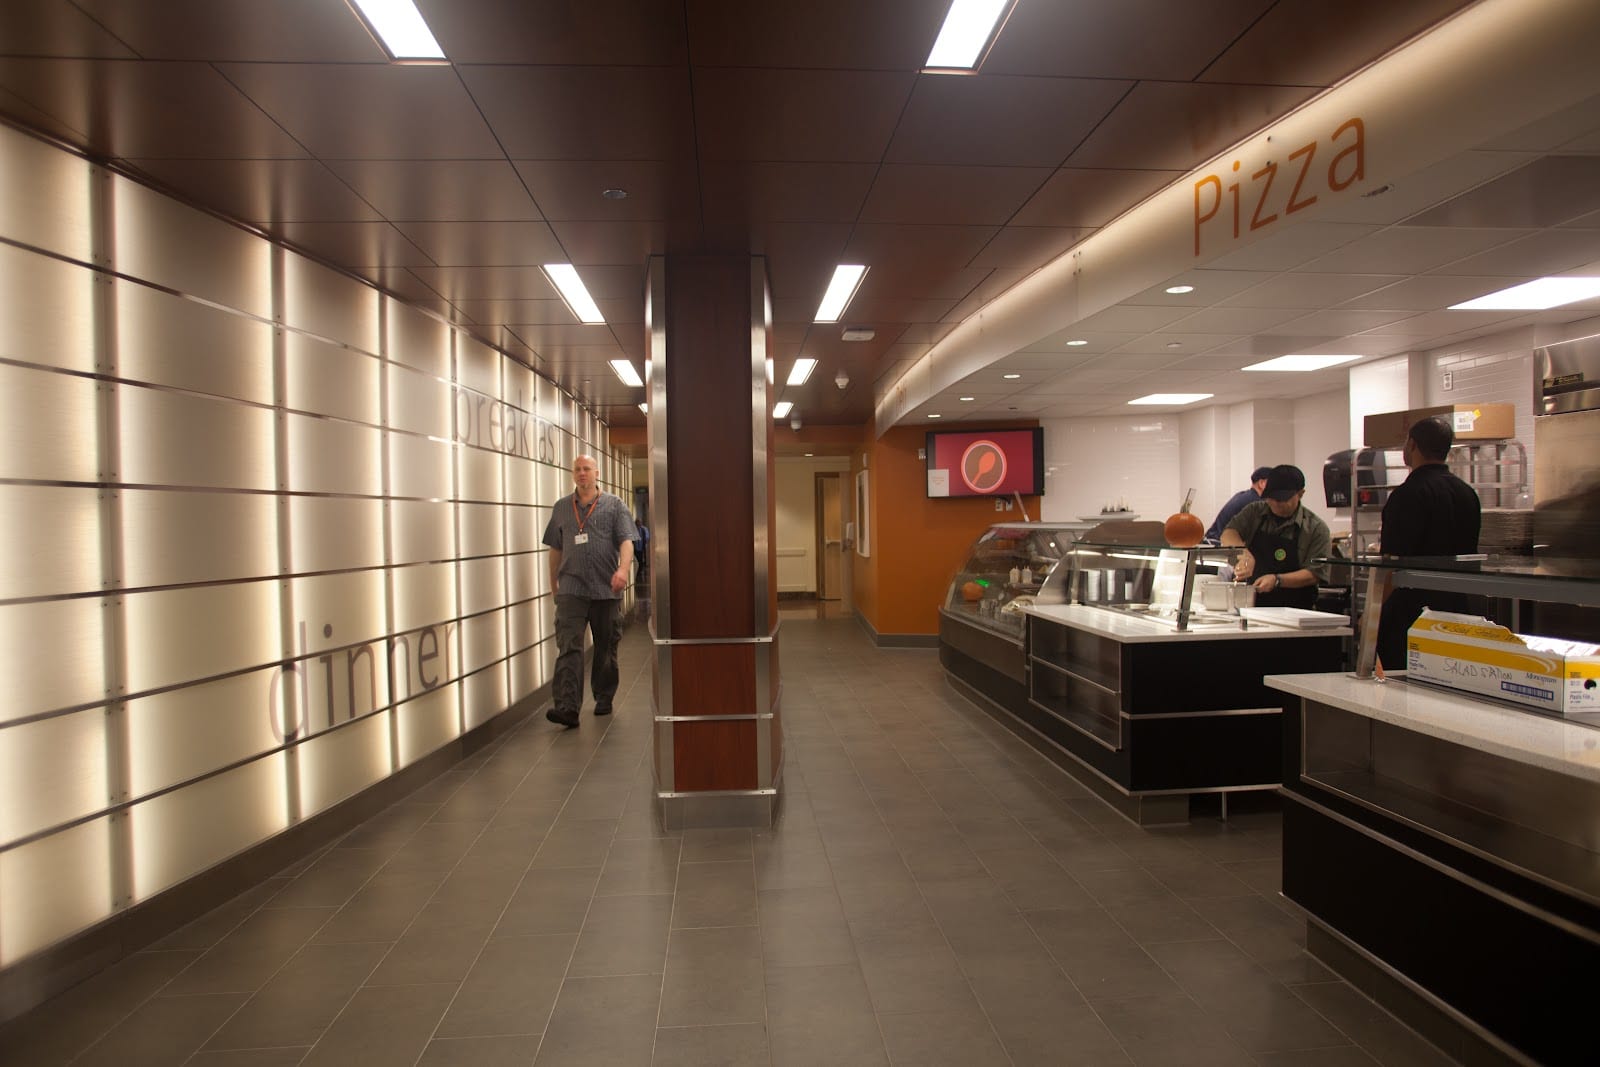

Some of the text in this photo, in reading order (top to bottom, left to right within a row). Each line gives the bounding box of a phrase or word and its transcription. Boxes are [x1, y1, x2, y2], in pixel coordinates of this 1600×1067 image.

[1194, 117, 1365, 257] Pizza
[453, 365, 561, 466] breakas
[269, 621, 456, 745] dinner
[1442, 657, 1478, 678] SALAD
